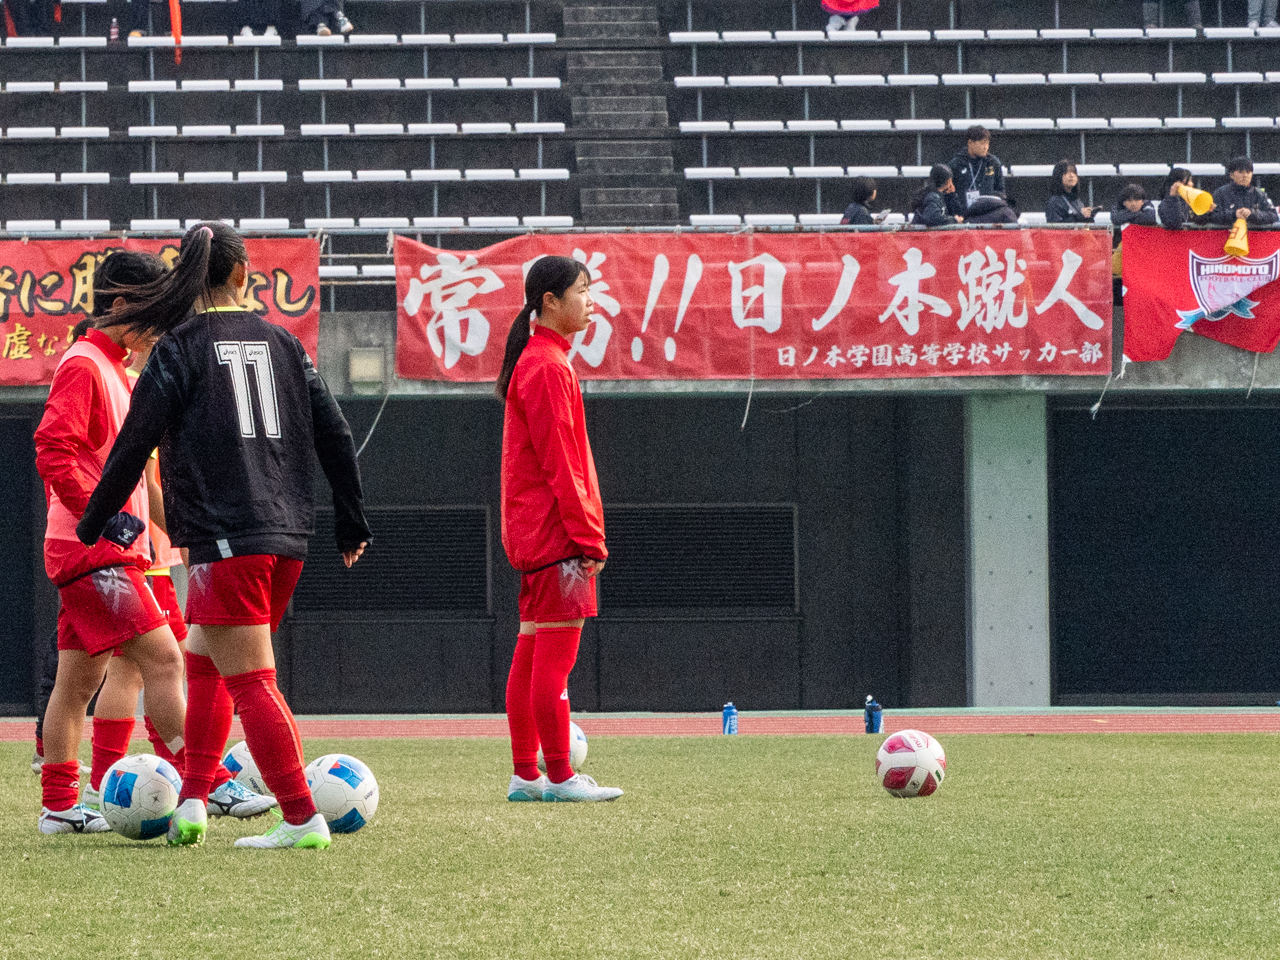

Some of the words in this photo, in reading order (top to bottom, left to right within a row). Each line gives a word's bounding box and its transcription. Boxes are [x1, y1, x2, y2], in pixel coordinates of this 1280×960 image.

[1200, 264, 1269, 276] HINOMOTO
[777, 341, 1104, 368] 日ノ本学園高等学校サッカー部
[213, 341, 282, 439] 11
